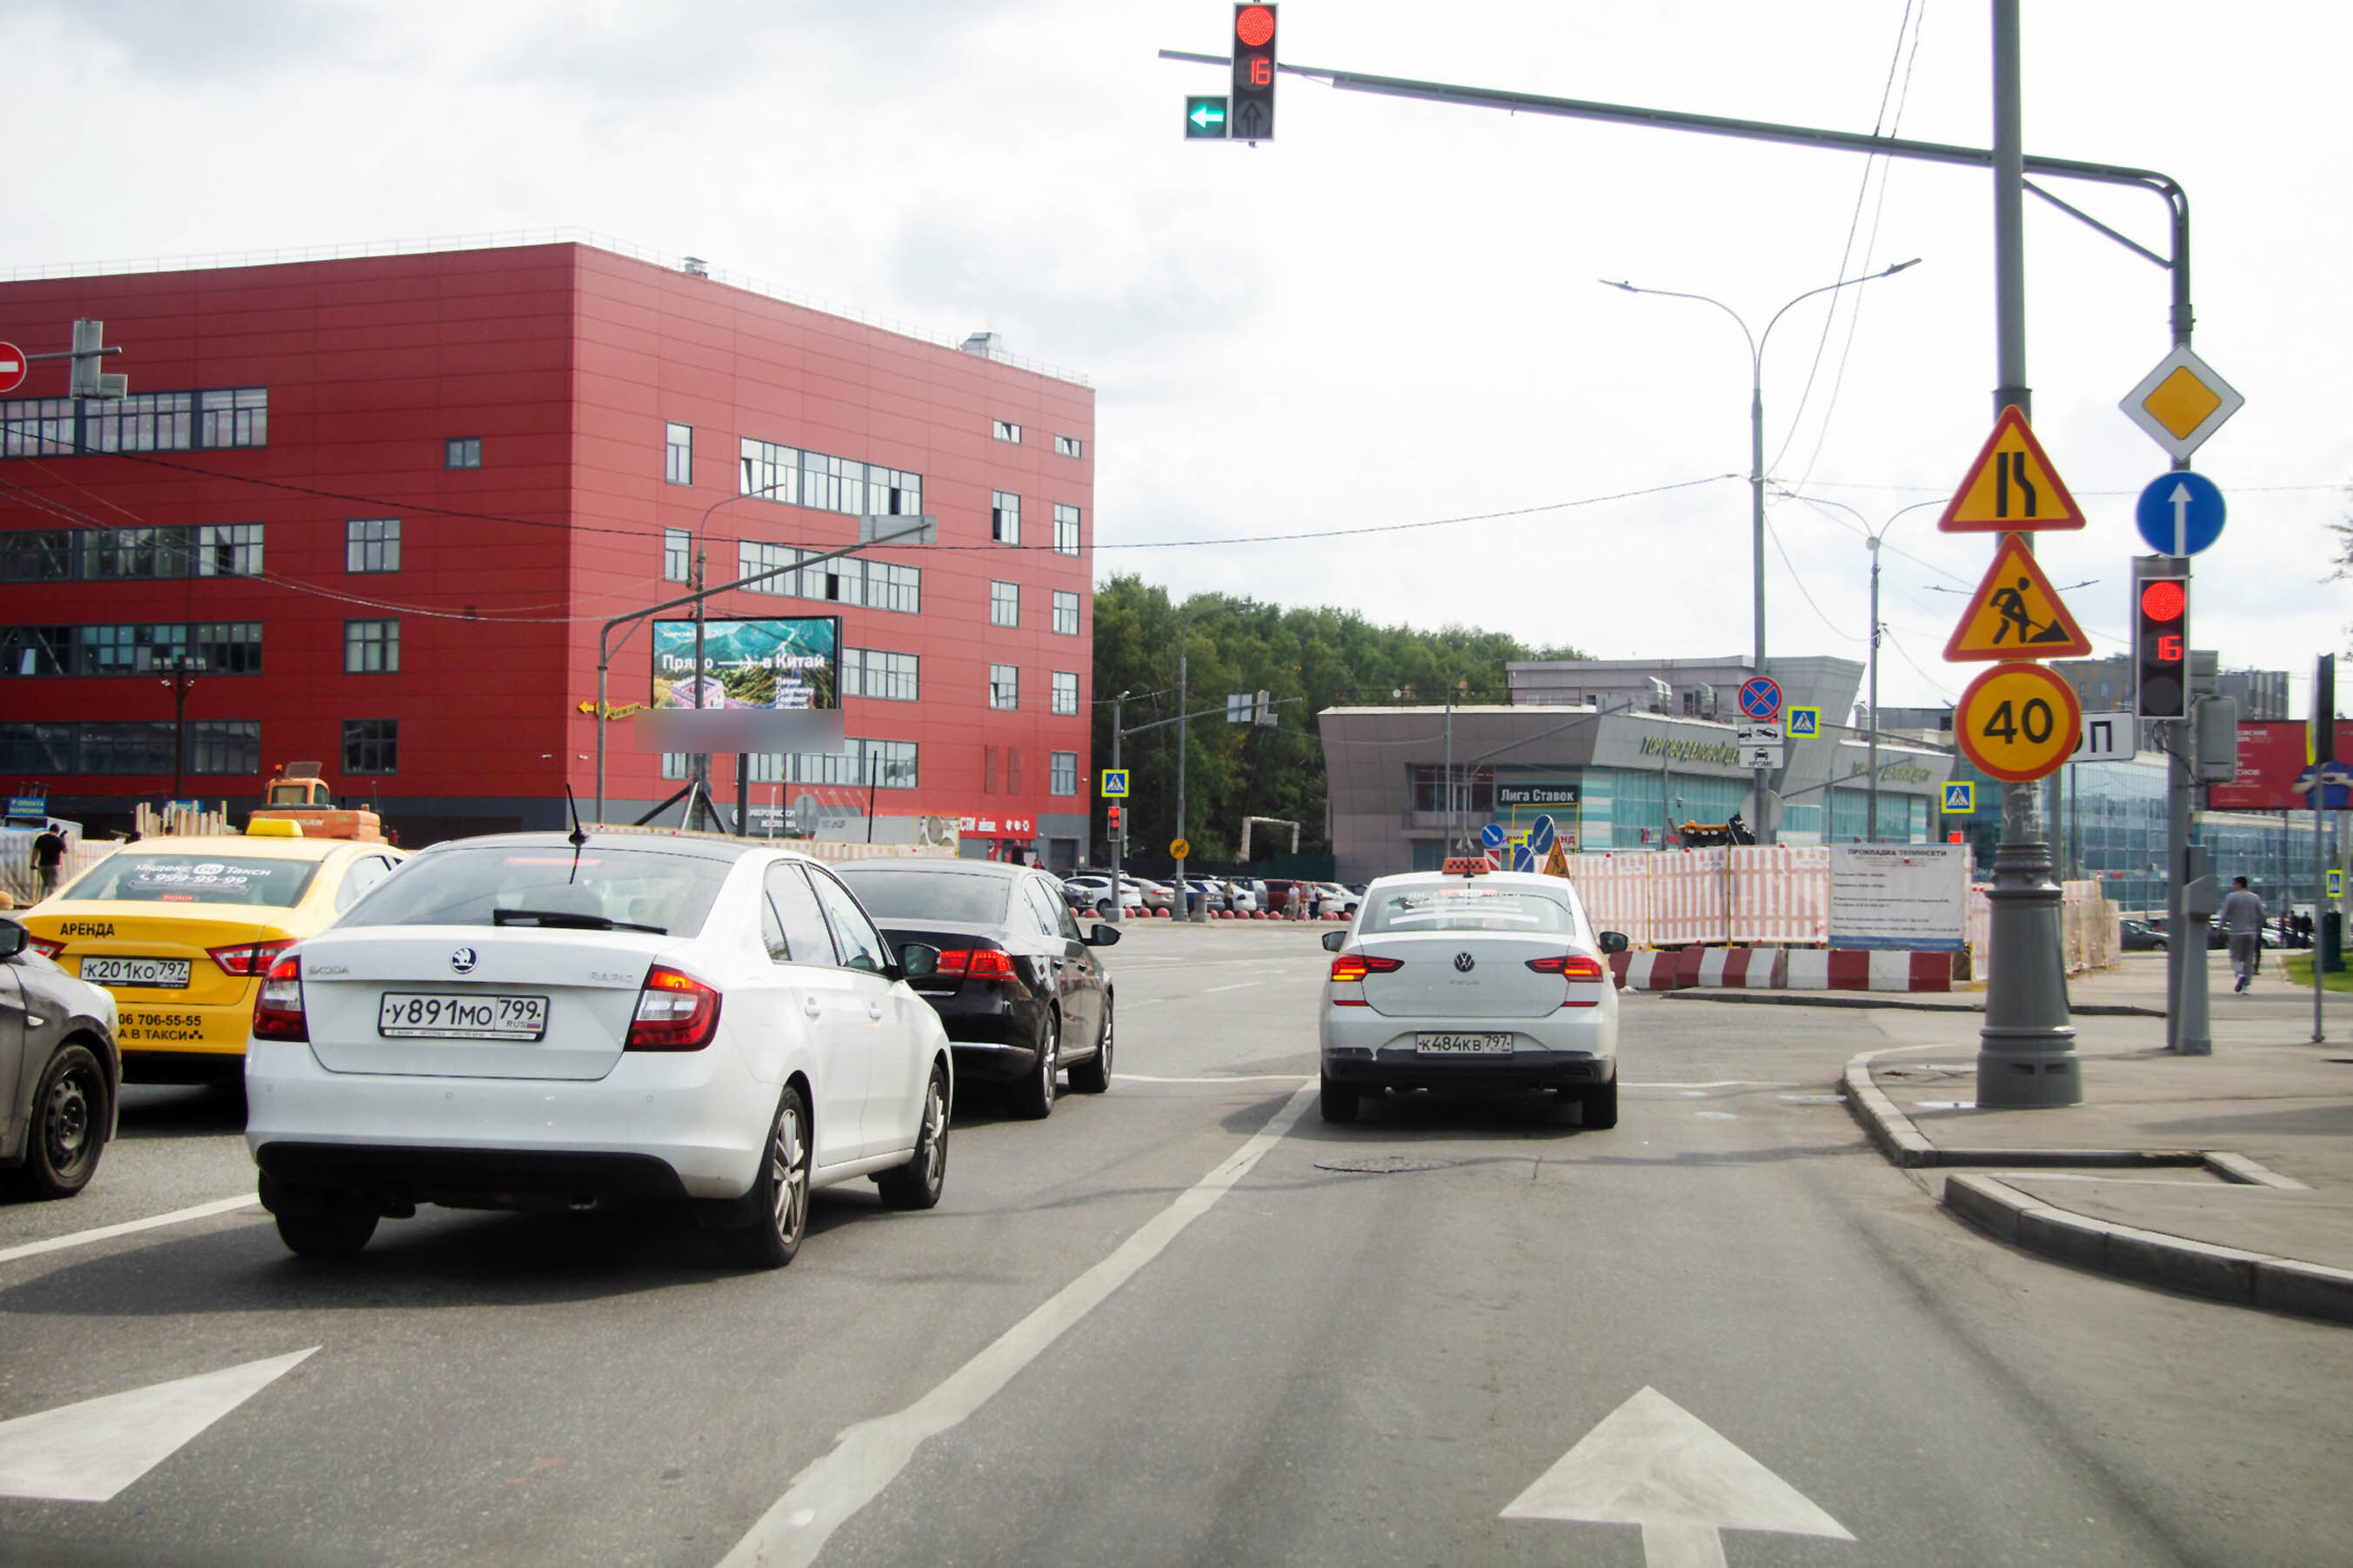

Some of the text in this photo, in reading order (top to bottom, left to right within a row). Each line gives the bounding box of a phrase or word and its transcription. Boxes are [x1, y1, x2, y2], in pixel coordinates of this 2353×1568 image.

[1250, 57, 1271, 85] 16
[2158, 635, 2183, 661] 16
[663, 653, 713, 673] Пряо
[776, 652, 826, 669] Китай
[1982, 697, 2055, 745] 40
[1501, 788, 1574, 802] Лига Ставок
[1848, 848, 1896, 857] ПРОКЛАДКА
[153, 873, 248, 884] 999-99-99
[60, 923, 115, 937] АРЕНДА
[159, 962, 185, 976] 797
[499, 999, 538, 1020] 799
[138, 1014, 202, 1026] 706-55-55
[146, 1030, 188, 1041] ТАКСИ
[1484, 1035, 1507, 1047] 797
